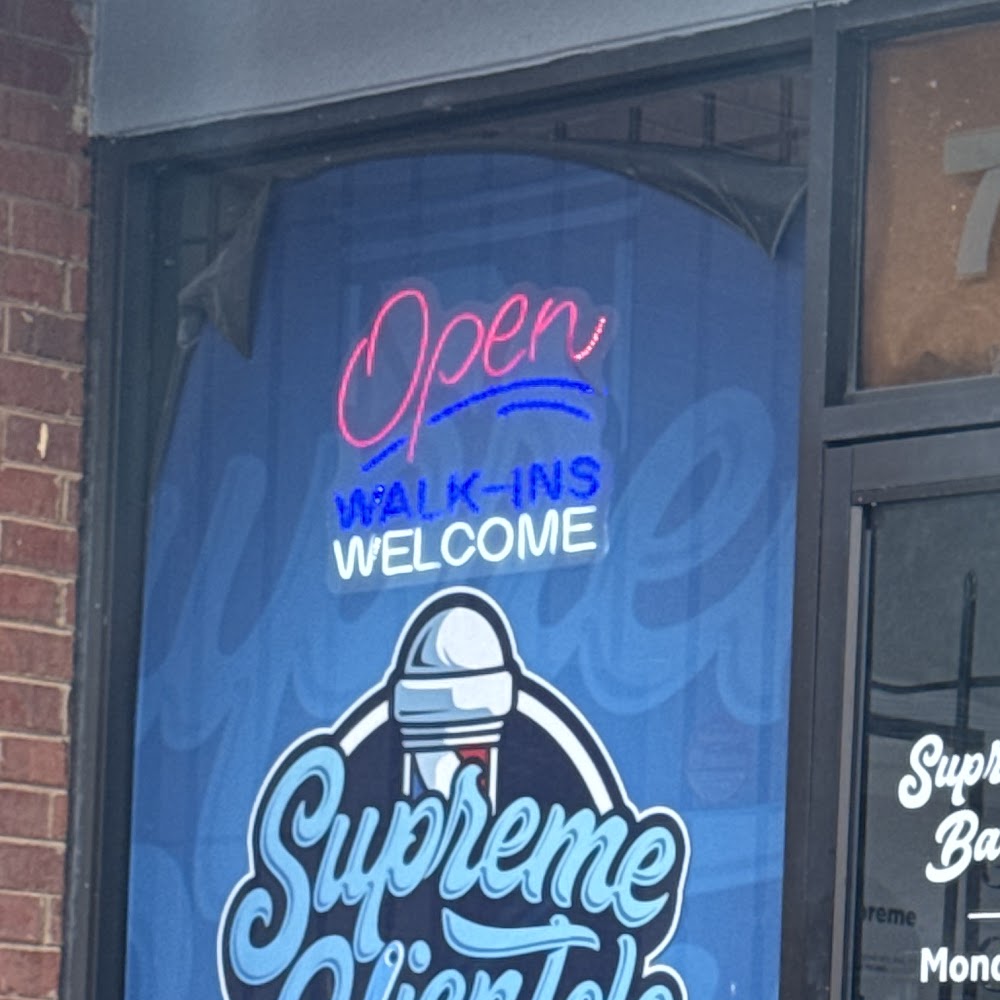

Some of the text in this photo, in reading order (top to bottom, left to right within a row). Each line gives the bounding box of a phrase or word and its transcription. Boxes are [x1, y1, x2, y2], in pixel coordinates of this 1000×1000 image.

[339, 290, 607, 461] Open
[333, 505, 597, 580] WELCOME
[335, 455, 601, 530] WALK-INS
[229, 745, 677, 985] Supreme
